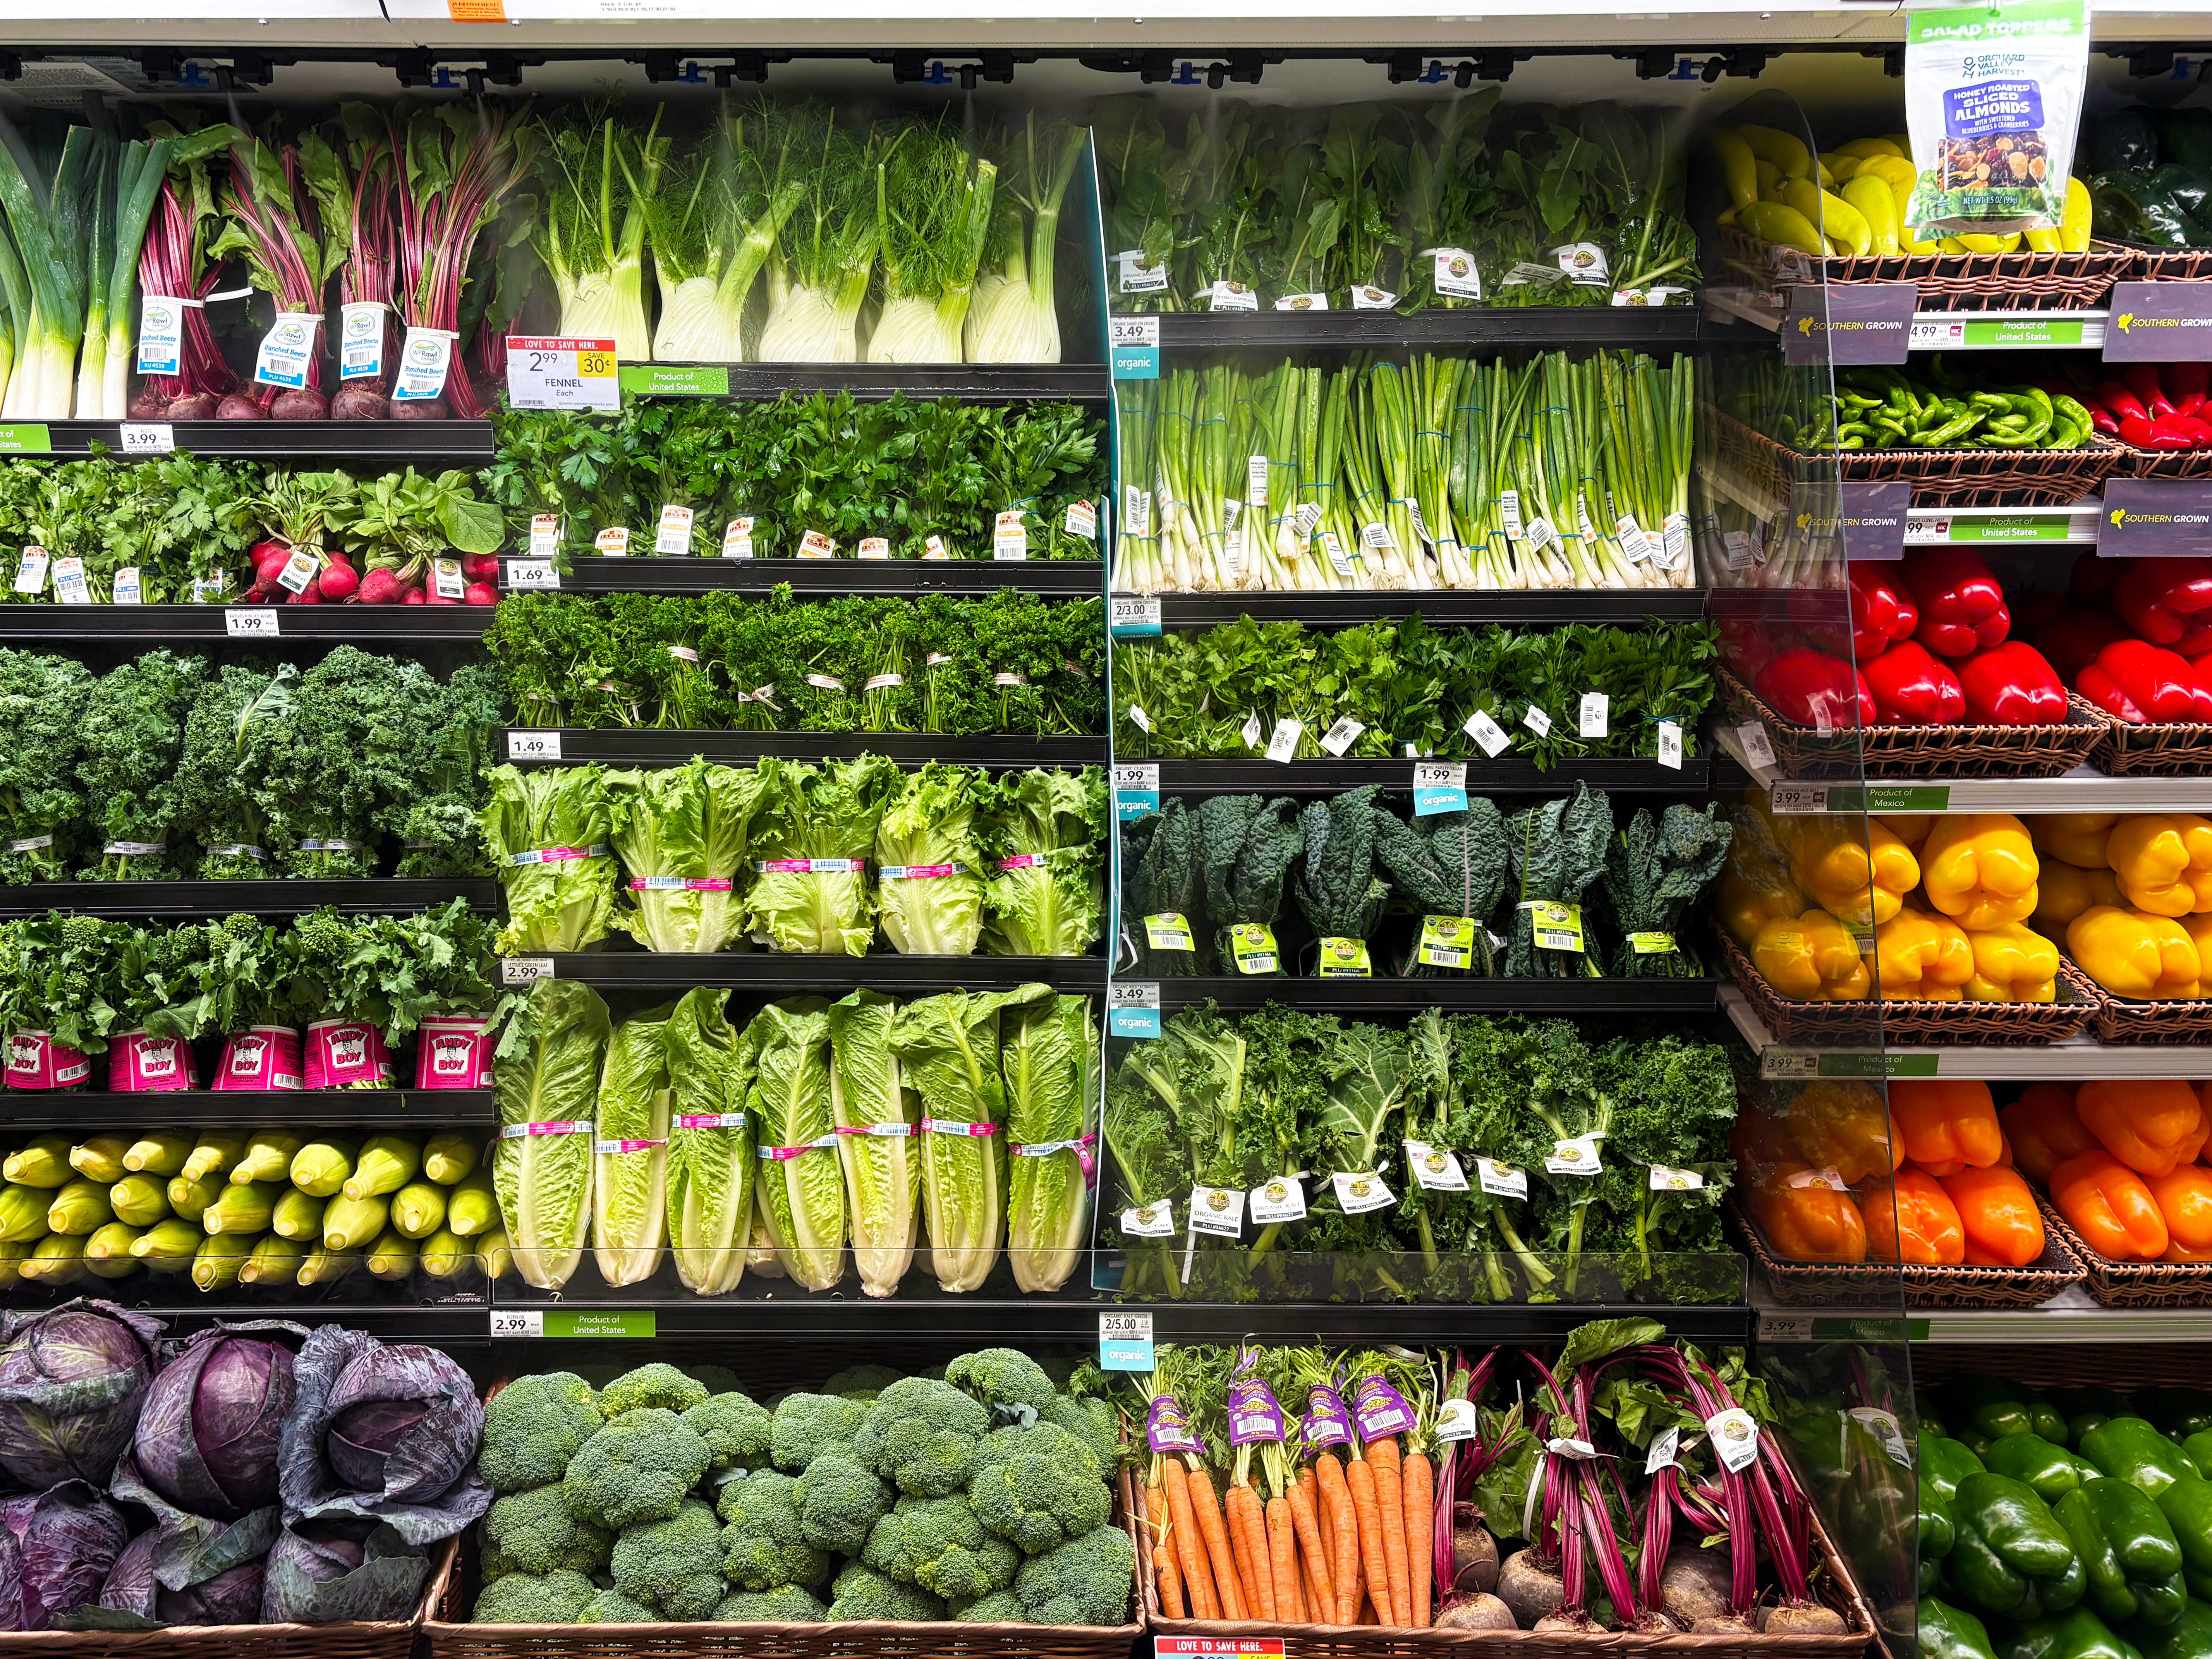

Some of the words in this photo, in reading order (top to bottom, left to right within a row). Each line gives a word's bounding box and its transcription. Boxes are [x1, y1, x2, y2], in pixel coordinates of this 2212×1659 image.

[1921, 24, 1982, 38] SALAD
[1986, 18, 2071, 35] TOPPERS
[1978, 54, 2025, 62] ORCHARD
[1978, 61, 2012, 69] VALLEY
[1978, 69, 2020, 77] HARVEST
[1954, 88, 1986, 100] HONEY
[1987, 84, 2030, 93] ROASTED
[1963, 92, 2019, 108] SLICED
[1954, 101, 2031, 121] ALMONDS
[1974, 118, 1987, 126] WITH
[1989, 115, 2015, 124] SWEETENED
[1961, 123, 1993, 134] BLUEBERRIES
[2004, 196, 2018, 205] (99g)
[1813, 322, 1863, 330] SOUTHERN
[2037, 321, 2046, 329] of
[2132, 319, 2179, 327] SOUTHERN
[1115, 326, 1143, 337] 3.49
[1911, 326, 1936, 337] 4.99
[1995, 332, 2023, 341] United
[2025, 333, 2051, 341] States
[344, 340, 363, 348] Bunched
[525, 340, 542, 348] LOVE
[546, 340, 555, 349] TO
[558, 341, 575, 349] SAVE
[579, 341, 598, 349] HERE.
[264, 345, 289, 354] Bunched
[290, 349, 307, 358] Beets
[1118, 356, 1151, 370] organic
[405, 366, 428, 374] Bunched
[654, 373, 684, 381] Product
[545, 379, 583, 387] FENNEL
[649, 383, 674, 391] United
[127, 434, 156, 444] 3.99
[1810, 518, 1860, 527] SOUTHERN
[1862, 518, 1897, 526] GROWN
[2024, 517, 2033, 525] of
[286, 568, 306, 582] RADISH
[513, 570, 543, 580] 1.69
[1116, 605, 1145, 615] 2/3.00
[232, 618, 261, 629] 1.99
[514, 741, 544, 751] 1.49
[1115, 771, 1143, 780] 1.99
[1421, 769, 1450, 780] 1.99
[1775, 793, 1800, 803] 3.99
[1870, 789, 1899, 798] Product
[1902, 788, 1913, 797] of
[1422, 793, 1459, 807] organic
[1875, 799, 1905, 807] Mexico
[1118, 799, 1151, 812] organic
[508, 967, 538, 977] 2.99
[1115, 989, 1143, 998] 3.49
[1118, 1017, 1152, 1029] organic
[13, 1035, 40, 1050] ANDY
[331, 1030, 365, 1045] ANDY
[140, 1038, 175, 1053] ANDY
[235, 1039, 266, 1050] ANDY
[436, 1038, 471, 1049] ANDY
[336, 1051, 362, 1064] BOY
[14, 1059, 36, 1069] BOY
[145, 1060, 171, 1072] BOY
[235, 1061, 258, 1071] BOY
[439, 1060, 465, 1070] BOY
[1767, 1058, 1792, 1068] 3.99
[1484, 1174, 1509, 1183] ORGANIC
[1371, 1191, 1386, 1199] KALE
[1195, 1211, 1222, 1219] ORGANIC
[496, 1319, 526, 1329] 2.99
[579, 1316, 607, 1324] Product
[1106, 1319, 1136, 1329] 2/5.00
[574, 1326, 599, 1334] United
[1764, 1322, 1795, 1330] 3.99
[1109, 1350, 1146, 1362] organic
[1728, 1443, 1749, 1454] ORGANIC
[1177, 1641, 1197, 1651] LOVE
[1202, 1641, 1212, 1651] TO
[1216, 1642, 1236, 1651] SAVE
[1240, 1642, 1263, 1651] HERE.
